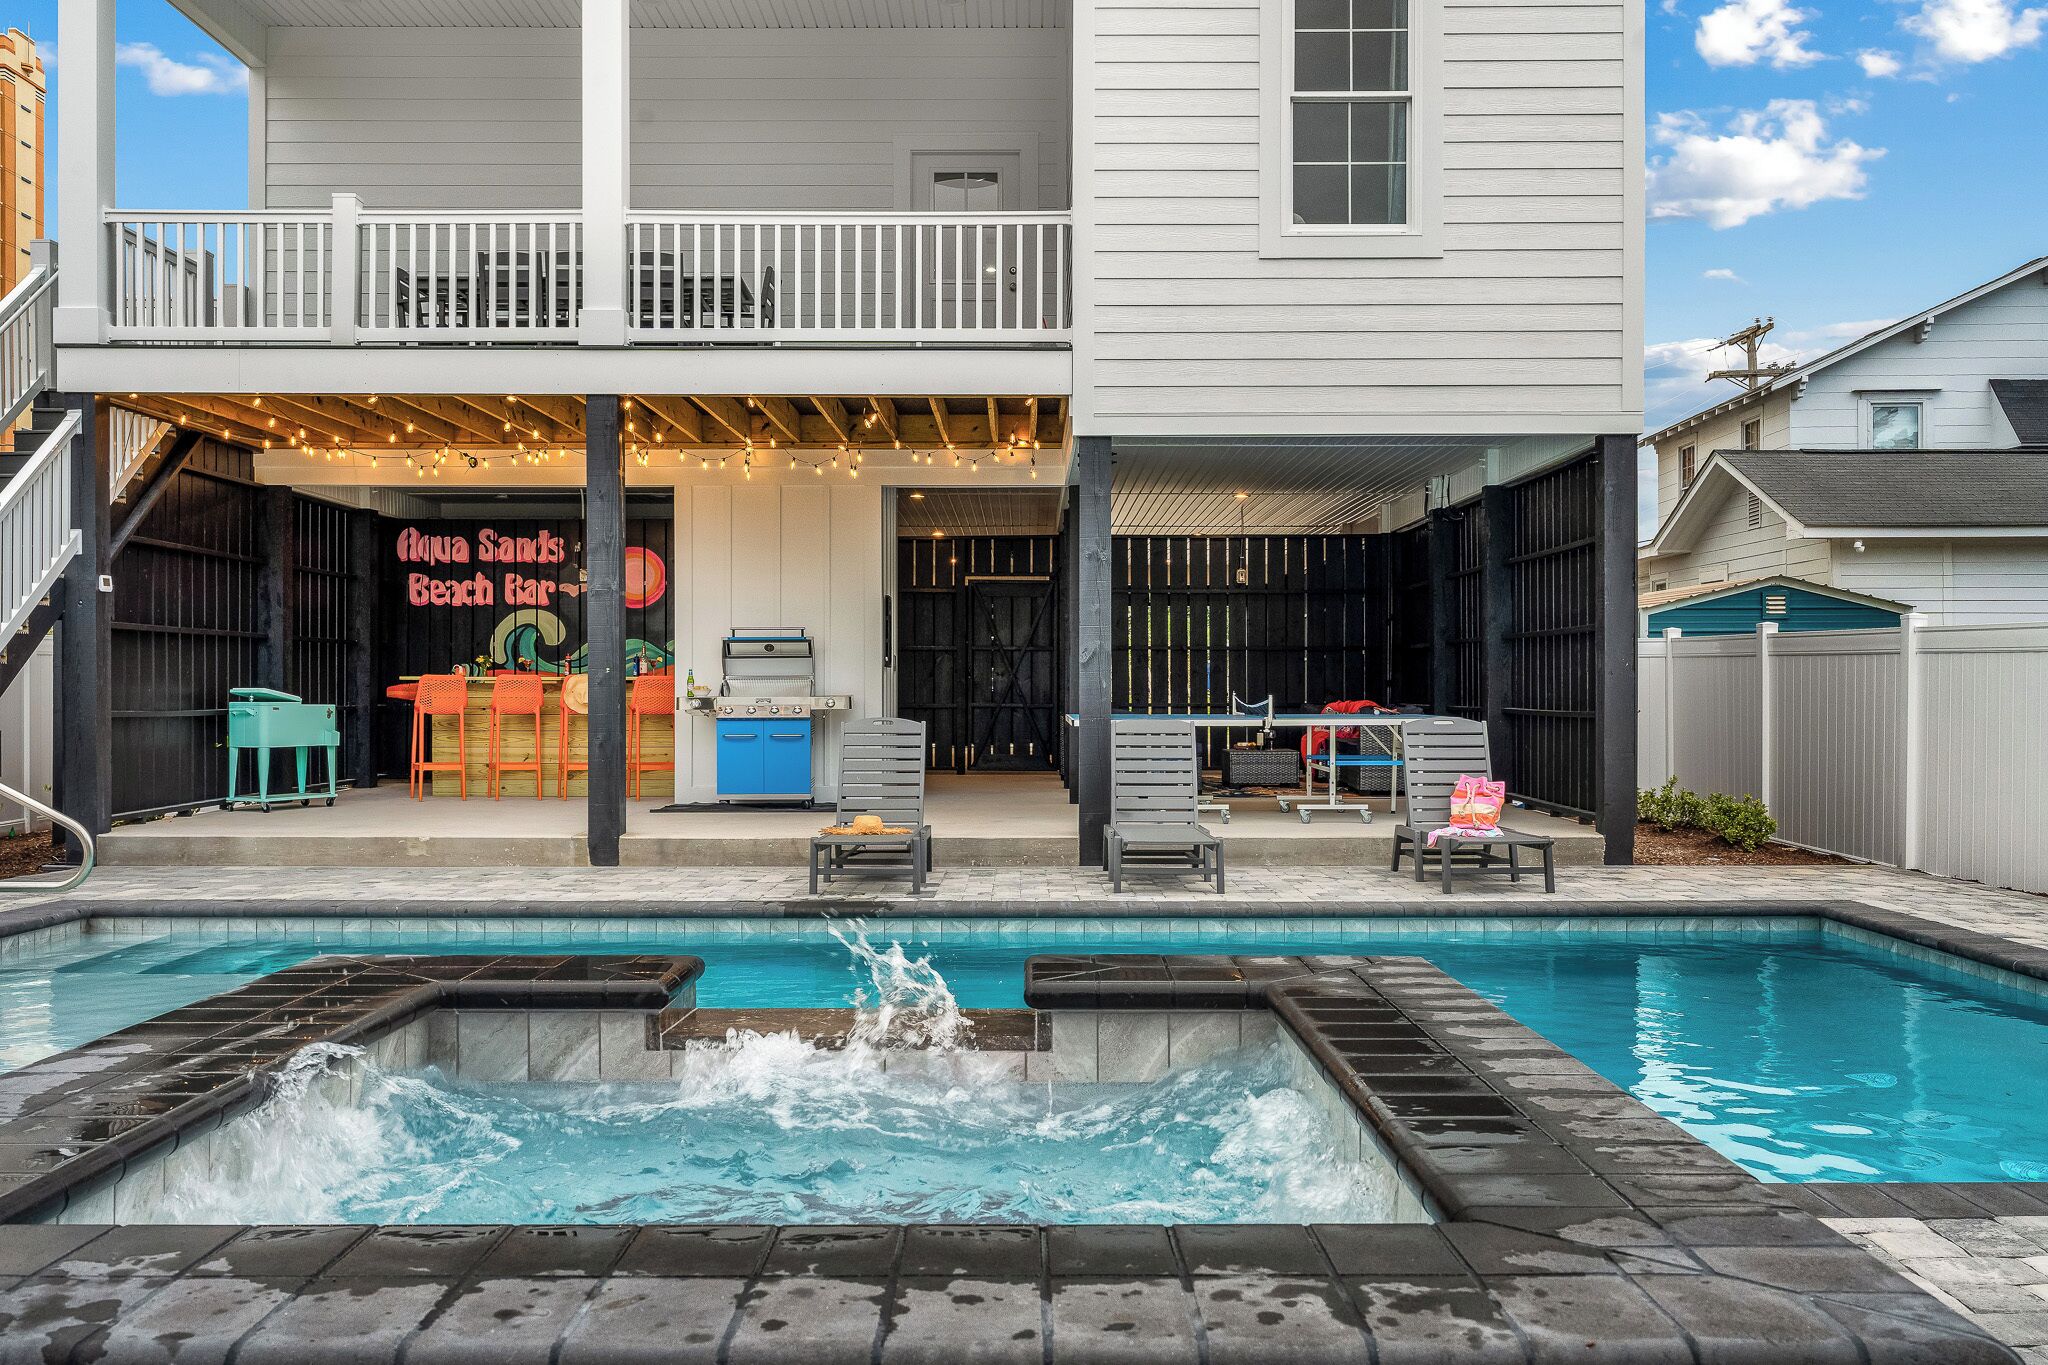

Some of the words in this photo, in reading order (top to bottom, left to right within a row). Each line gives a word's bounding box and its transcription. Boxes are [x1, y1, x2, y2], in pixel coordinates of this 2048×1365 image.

[397, 527, 469, 566] Aqua
[479, 528, 565, 563] Sands
[408, 572, 494, 606] Beach
[505, 573, 557, 606] Bar
